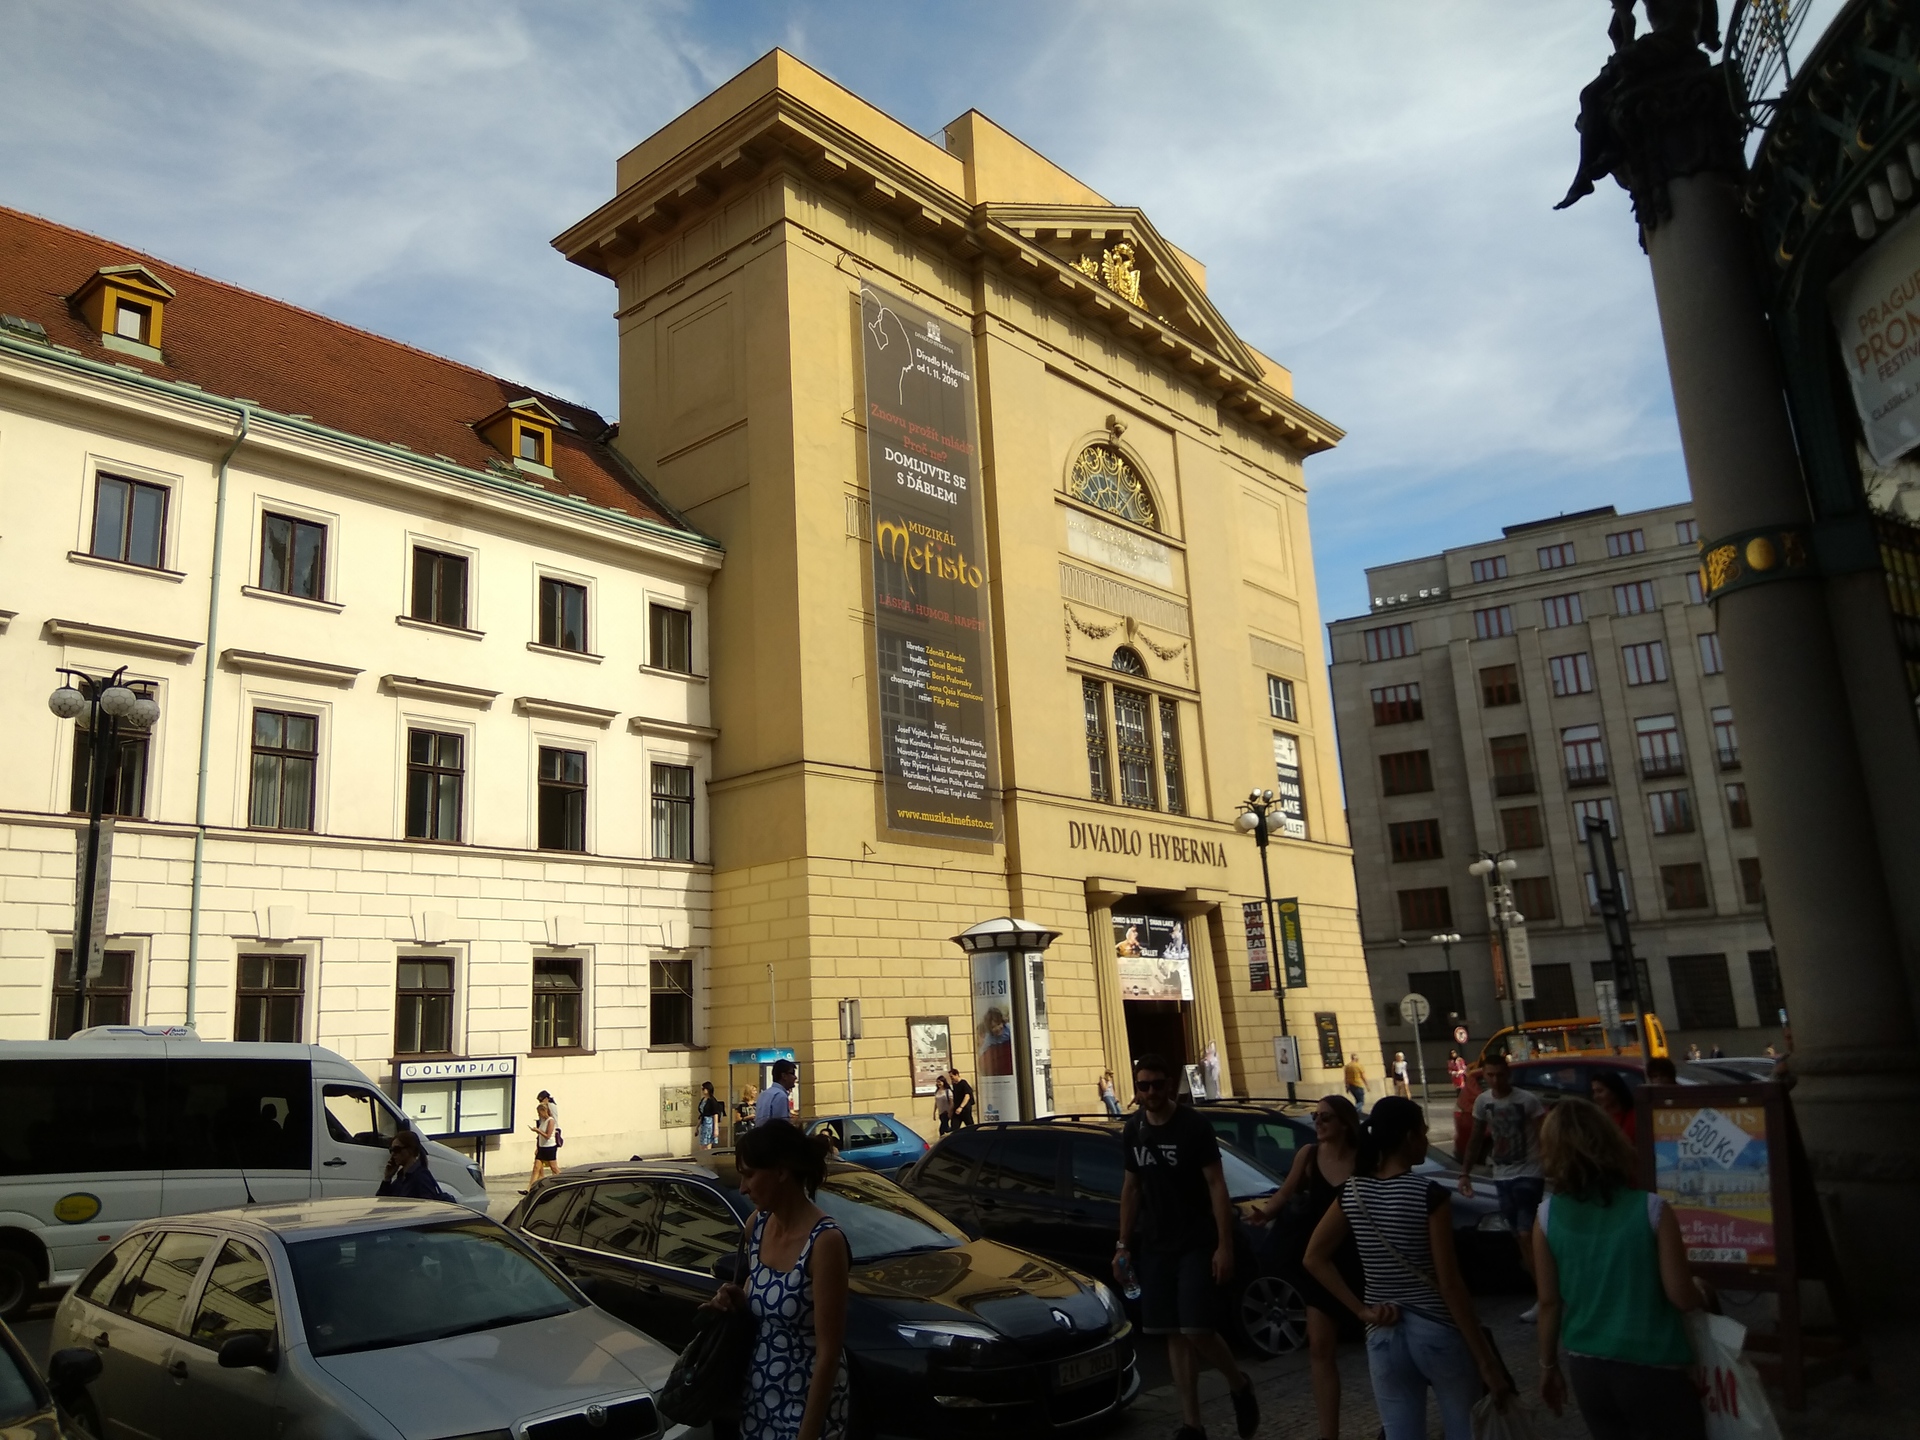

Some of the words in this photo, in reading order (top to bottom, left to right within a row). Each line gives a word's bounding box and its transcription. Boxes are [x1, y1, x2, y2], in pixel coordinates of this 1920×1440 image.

[916, 347, 941, 368] Divadlo
[941, 360, 971, 382] Hybernia
[916, 362, 926, 373] od
[926, 366, 933, 376] 1.
[932, 368, 942, 380] 11.
[942, 373, 959, 388] 2016
[870, 402, 907, 429] Znovu
[908, 421, 939, 443] prožít
[903, 435, 928, 456] Proč
[929, 449, 948, 463] ne?
[884, 447, 951, 485] DOMLUVTE
[952, 474, 967, 490] SE
[896, 471, 905, 486] S
[906, 471, 958, 505] ĎÁBLEM!
[908, 520, 957, 547] MUZIKÁL
[877, 513, 983, 597] Mefisto
[879, 593, 915, 614] LÁSKA,
[915, 603, 953, 624] HUMOR,
[925, 645, 945, 658] Zdeněk
[945, 650, 966, 663] Zelenka
[928, 658, 946, 670] Daniel
[901, 665, 917, 677] texty
[931, 671, 946, 682] Boris
[933, 695, 945, 708] Filip
[929, 730, 939, 740] Jan
[950, 756, 965, 767] Hana
[970, 748, 987, 760] Michal
[899, 758, 912, 768] Petr
[931, 763, 947, 774] Lukáš
[931, 774, 949, 786] Martin
[933, 785, 950, 797] Tomáš
[1278, 781, 1300, 798] WAN
[896, 808, 994, 830] www.muzikalmefisto.cz
[1284, 822, 1303, 835] ALLET
[1068, 820, 1142, 857] DIVADLO
[1148, 832, 1228, 868] HYBERNIA
[1243, 903, 1263, 913] ALL
[1245, 915, 1263, 925] YOU
[1246, 926, 1265, 937] CAN
[1284, 915, 1299, 962] SUBWAY
[1247, 938, 1267, 949] EAT
[998, 979, 1007, 995] SI
[1688, 1118, 1719, 1149] 500
[1133, 1144, 1179, 1167] VAS
